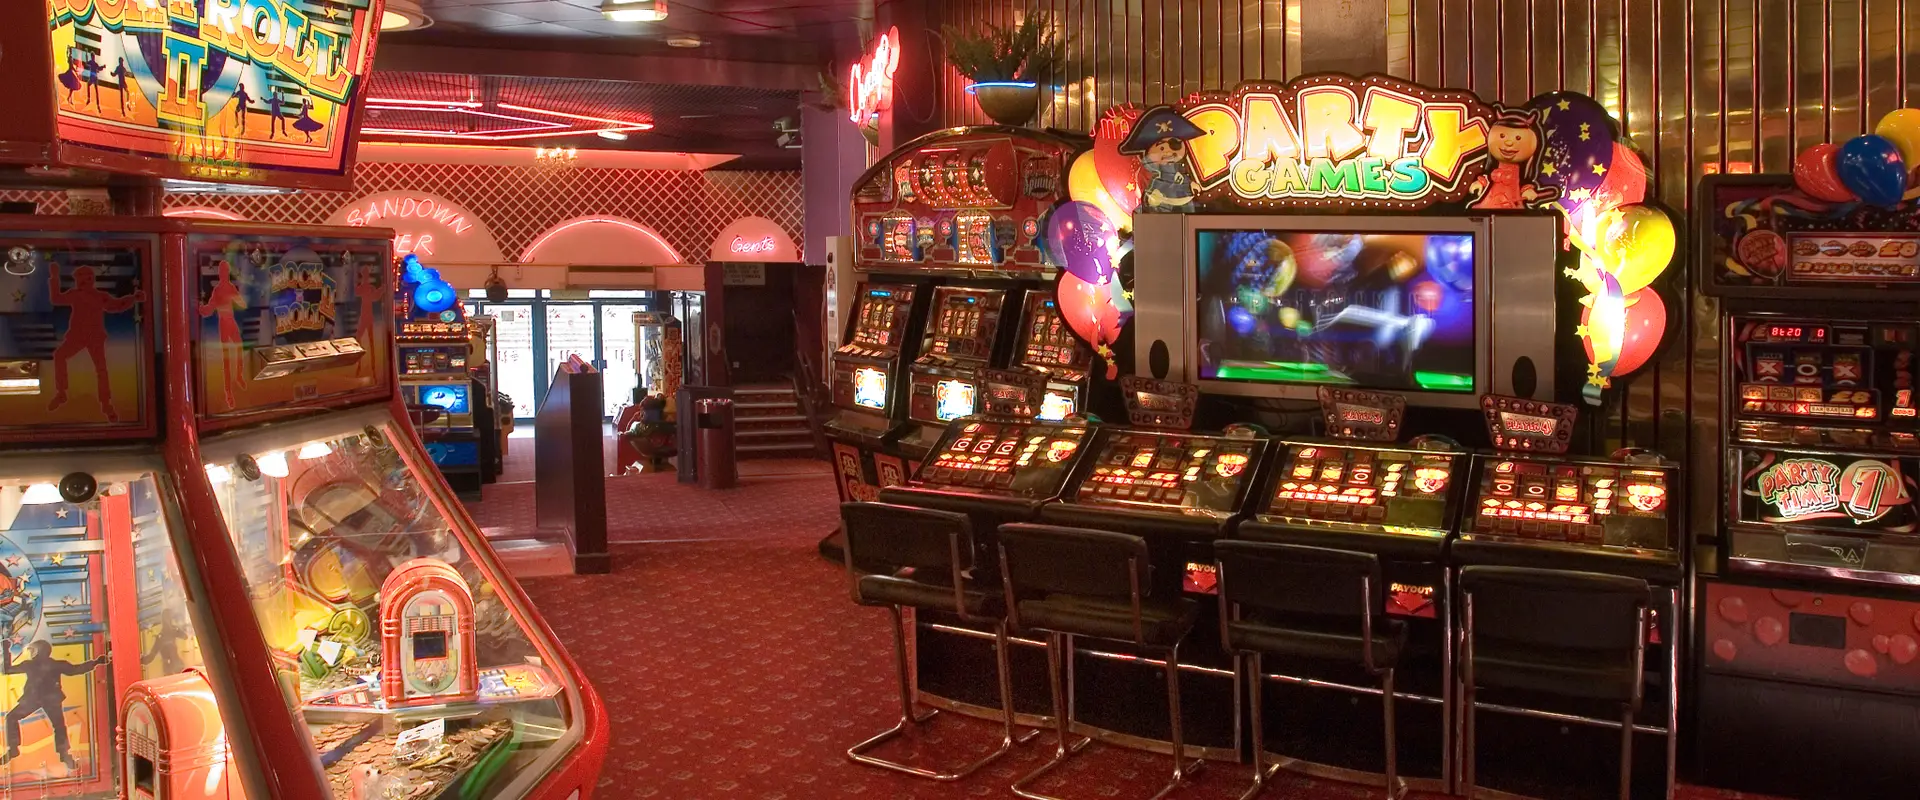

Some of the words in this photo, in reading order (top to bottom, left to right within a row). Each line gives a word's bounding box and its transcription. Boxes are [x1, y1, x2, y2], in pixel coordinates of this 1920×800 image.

[1183, 85, 1489, 182] PARTY
[1232, 156, 1429, 194] GAMES
[346, 197, 473, 234] SANDOWN
[730, 236, 775, 253] Gents
[269, 261, 323, 293] ROCK
[274, 301, 325, 335] ROLL
[1505, 417, 1541, 433] PLAYER
[1541, 419, 1553, 436] 4
[1761, 460, 1834, 500] PARTY
[1778, 483, 1836, 513] TIME
[1186, 562, 1217, 573] PAYOU
[1390, 582, 1432, 595] PAYOUT
